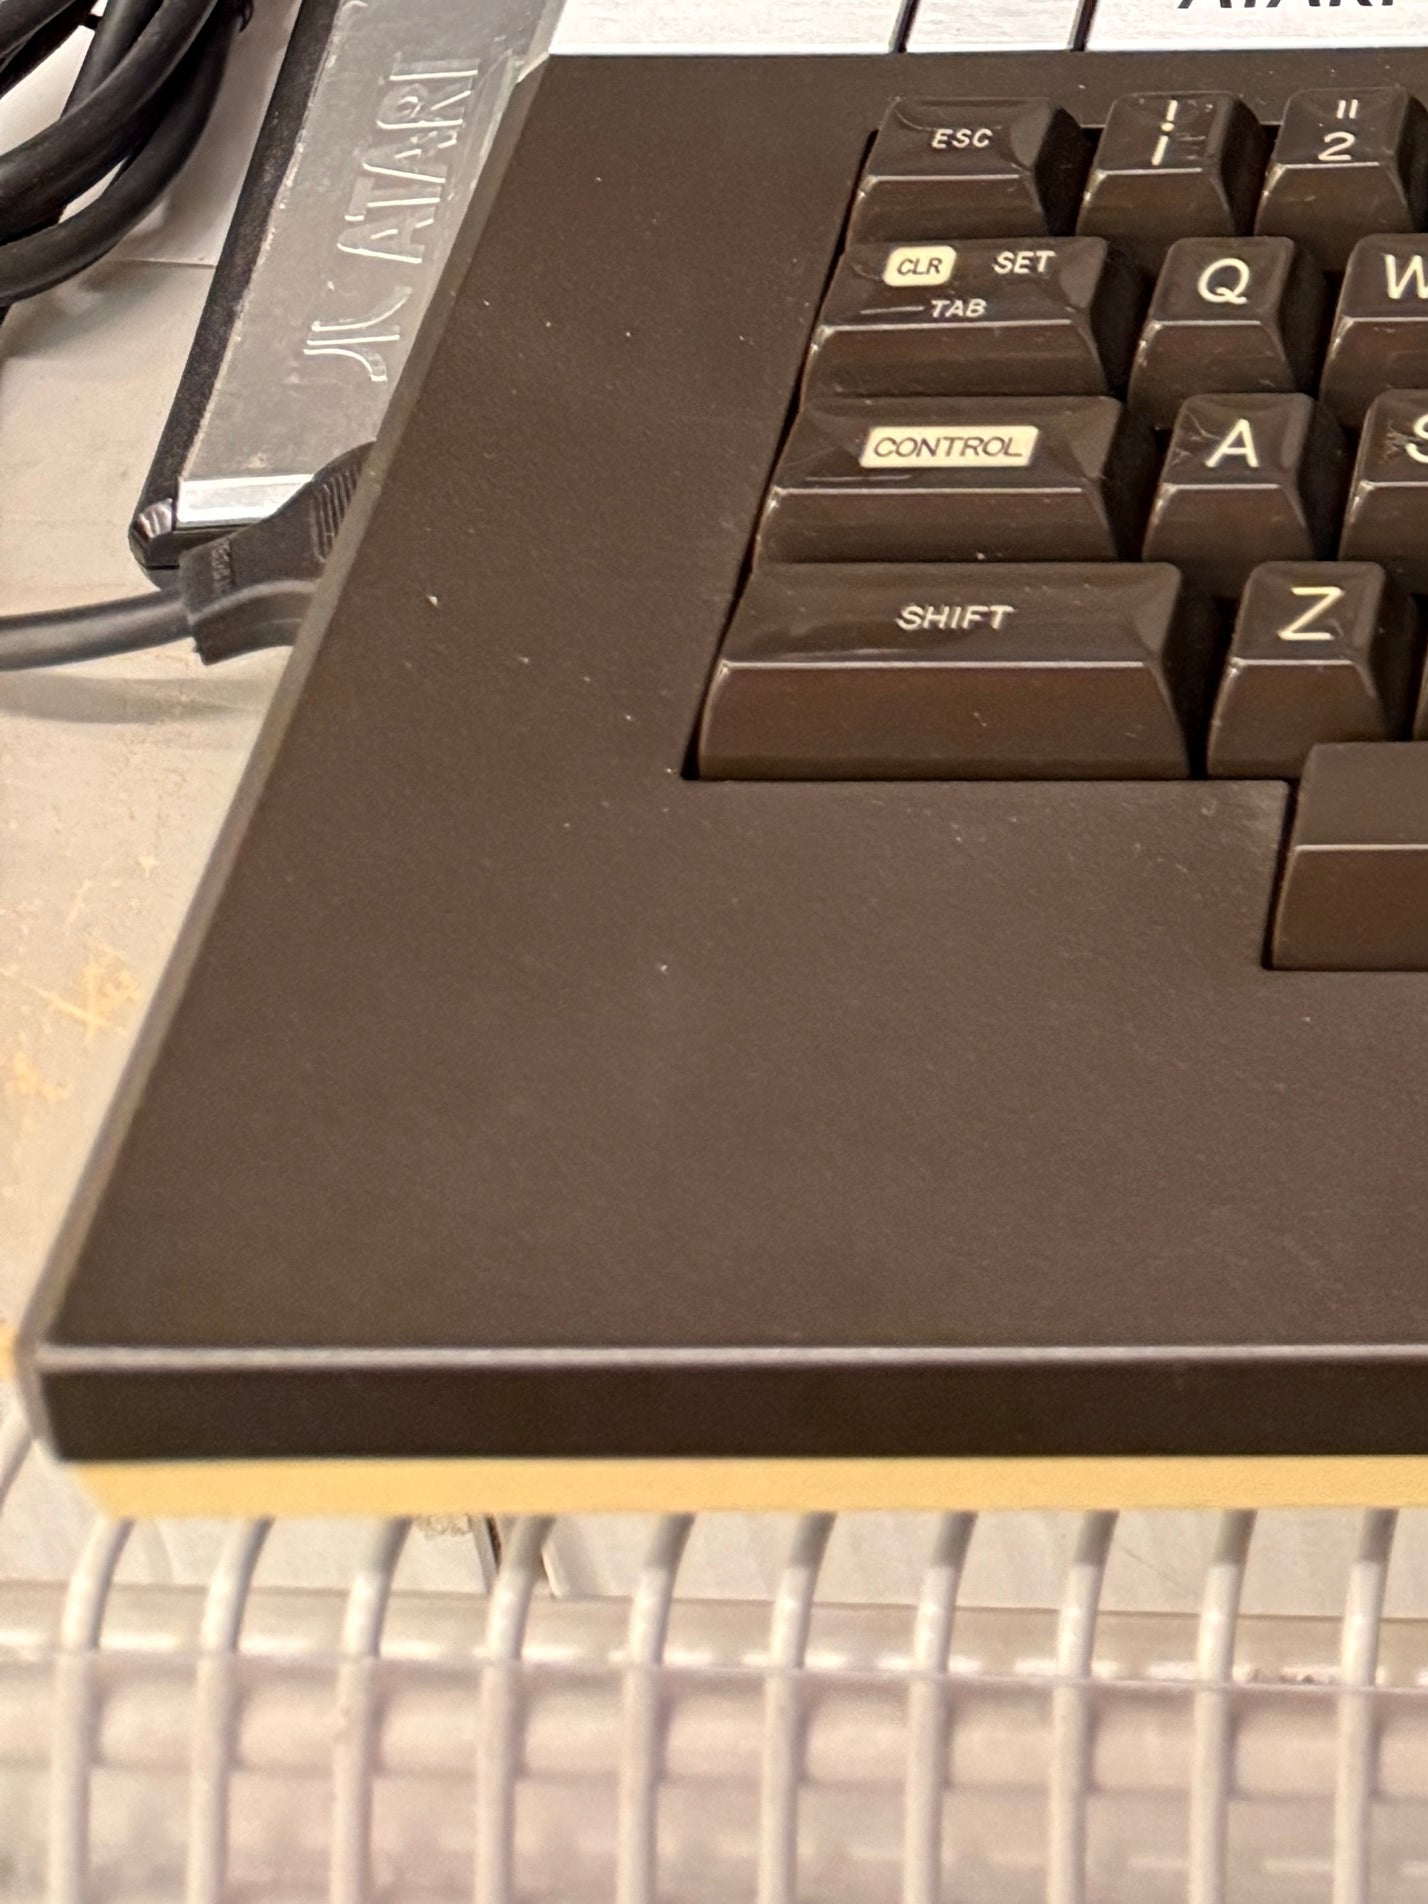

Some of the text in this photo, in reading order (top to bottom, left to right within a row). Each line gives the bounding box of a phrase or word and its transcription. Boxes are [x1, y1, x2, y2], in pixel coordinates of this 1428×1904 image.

[931, 127, 993, 149] ESC
[1317, 132, 1352, 160] 2
[896, 250, 1056, 276] CLR SET
[1197, 257, 1251, 305] Q
[930, 298, 987, 319] TAB
[872, 436, 1024, 458] CONTROL
[1205, 418, 1260, 469] A
[895, 604, 1014, 631] SHIFT
[1276, 585, 1344, 641] Z
